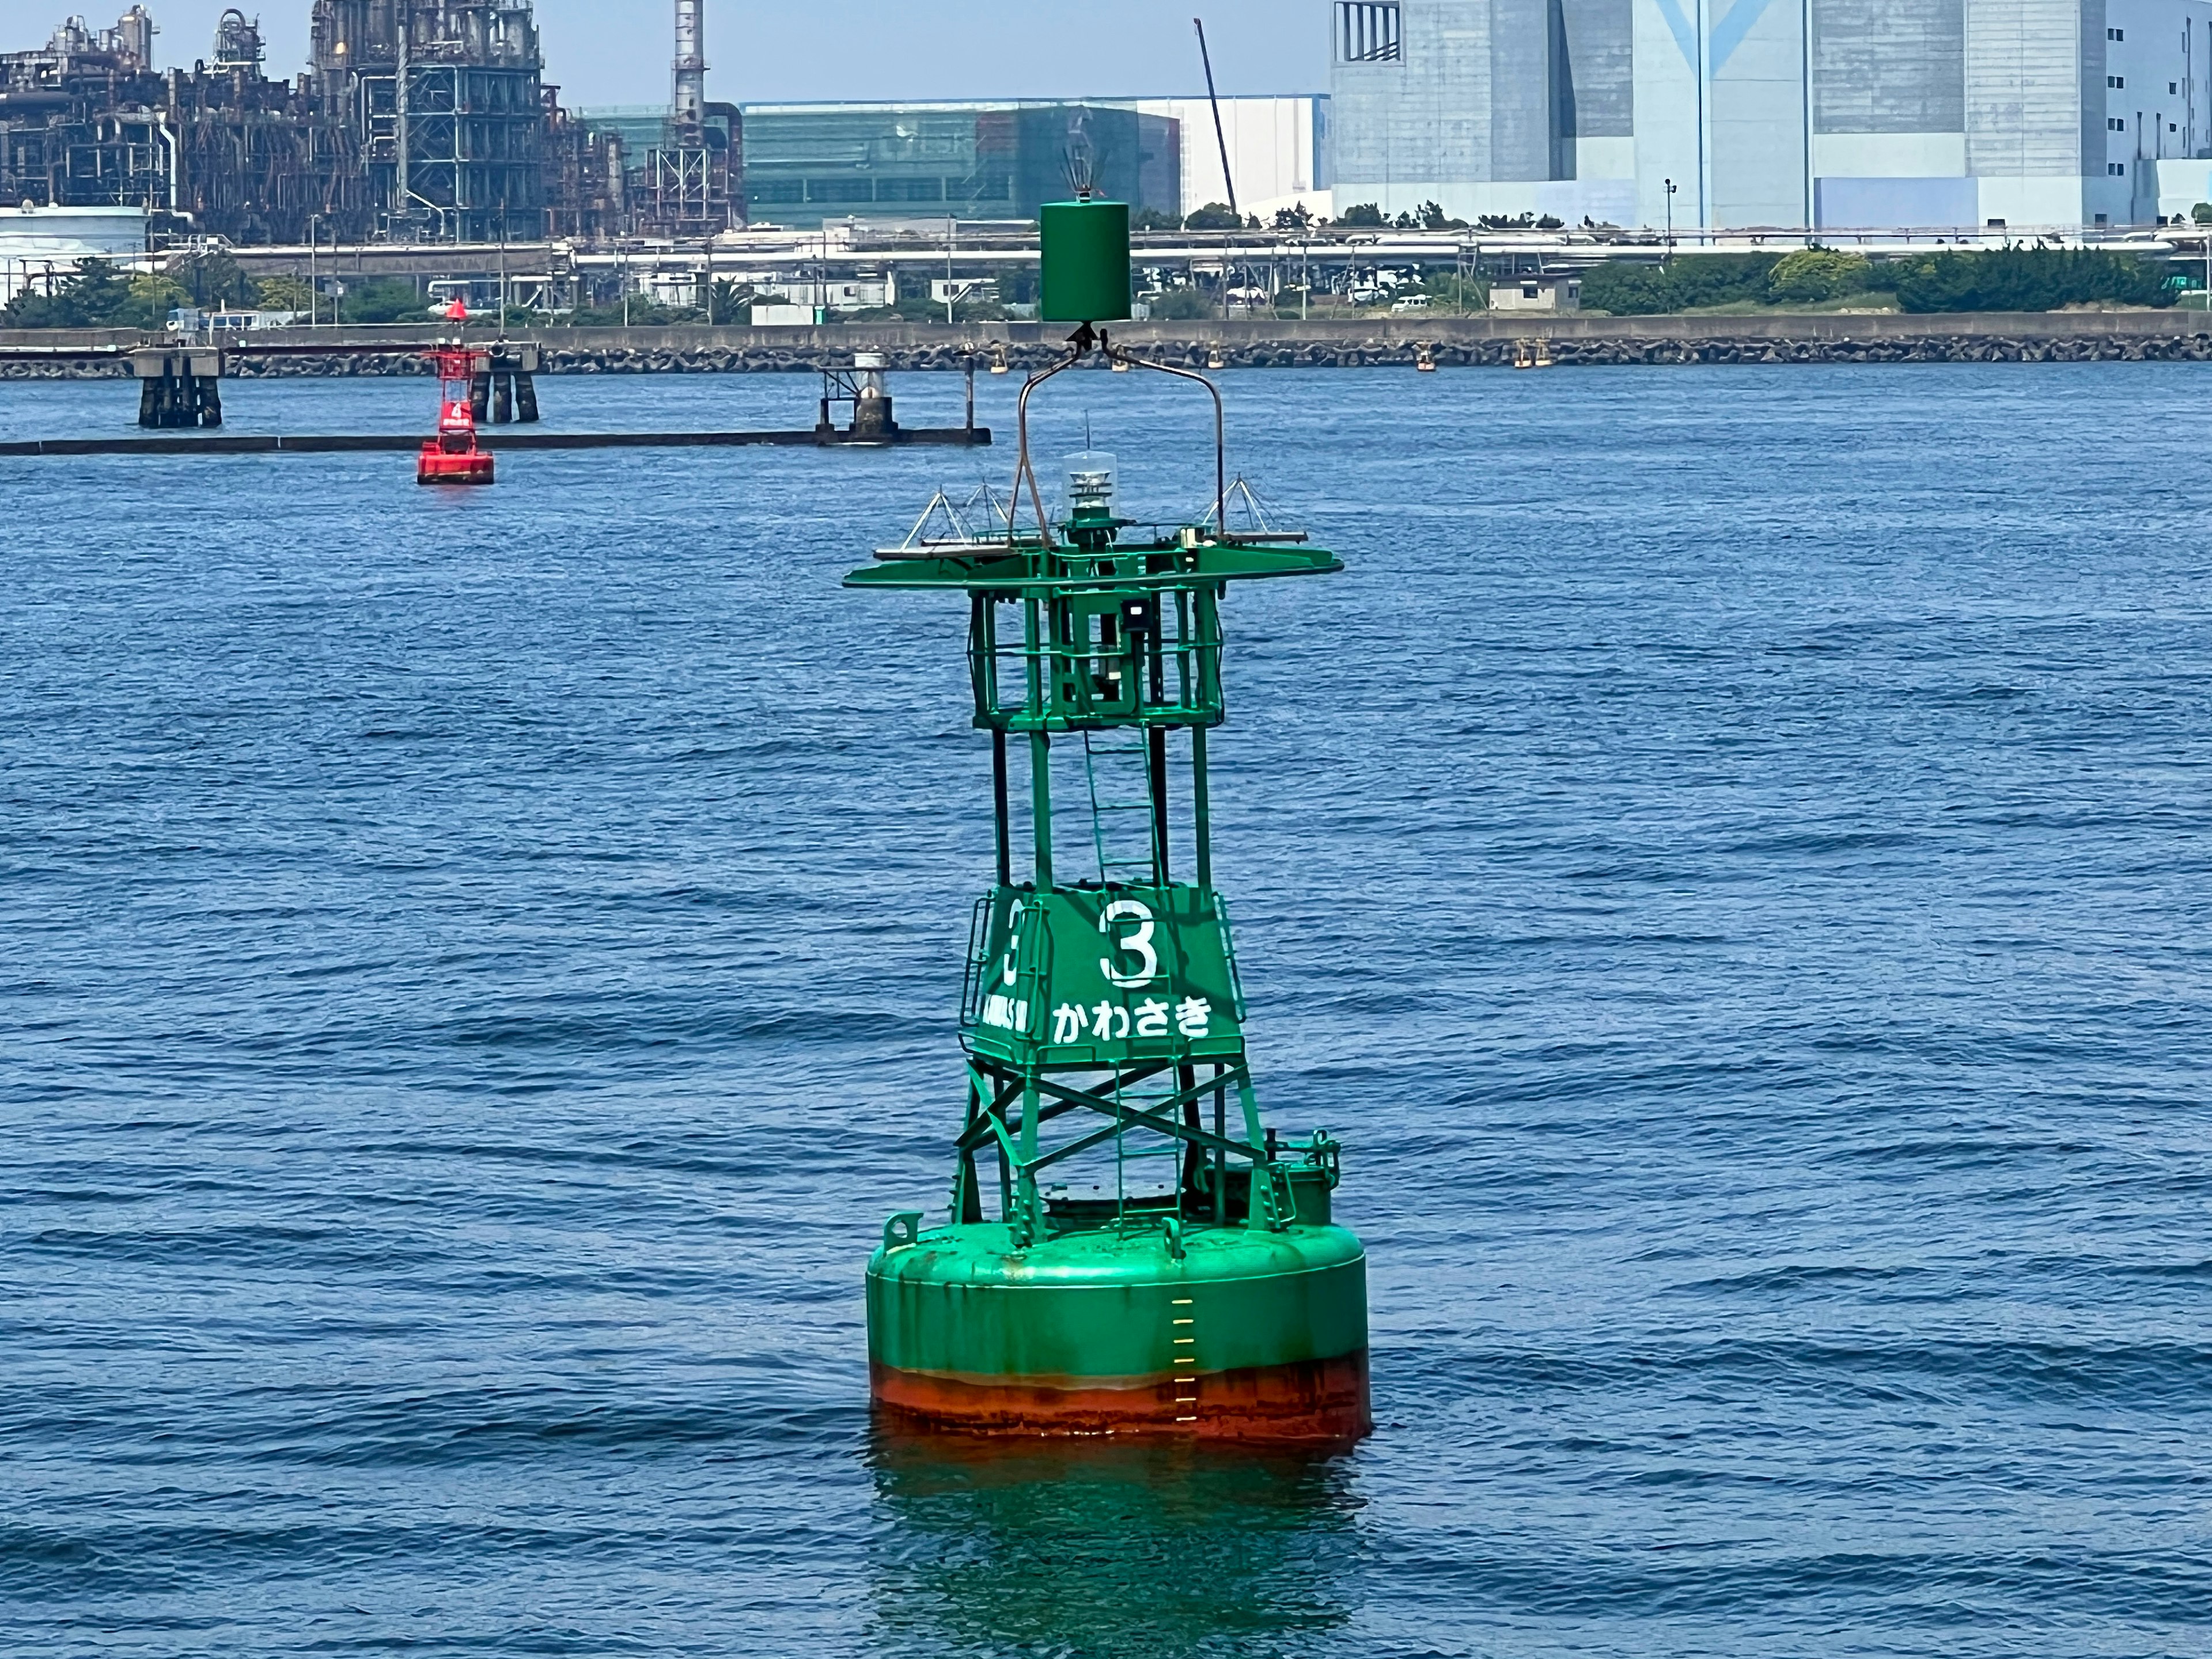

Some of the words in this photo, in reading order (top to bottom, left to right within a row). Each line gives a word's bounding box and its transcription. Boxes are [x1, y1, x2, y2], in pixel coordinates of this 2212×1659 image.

[1099, 900, 1157, 988] 3
[1052, 995, 1211, 1044] かわさき
